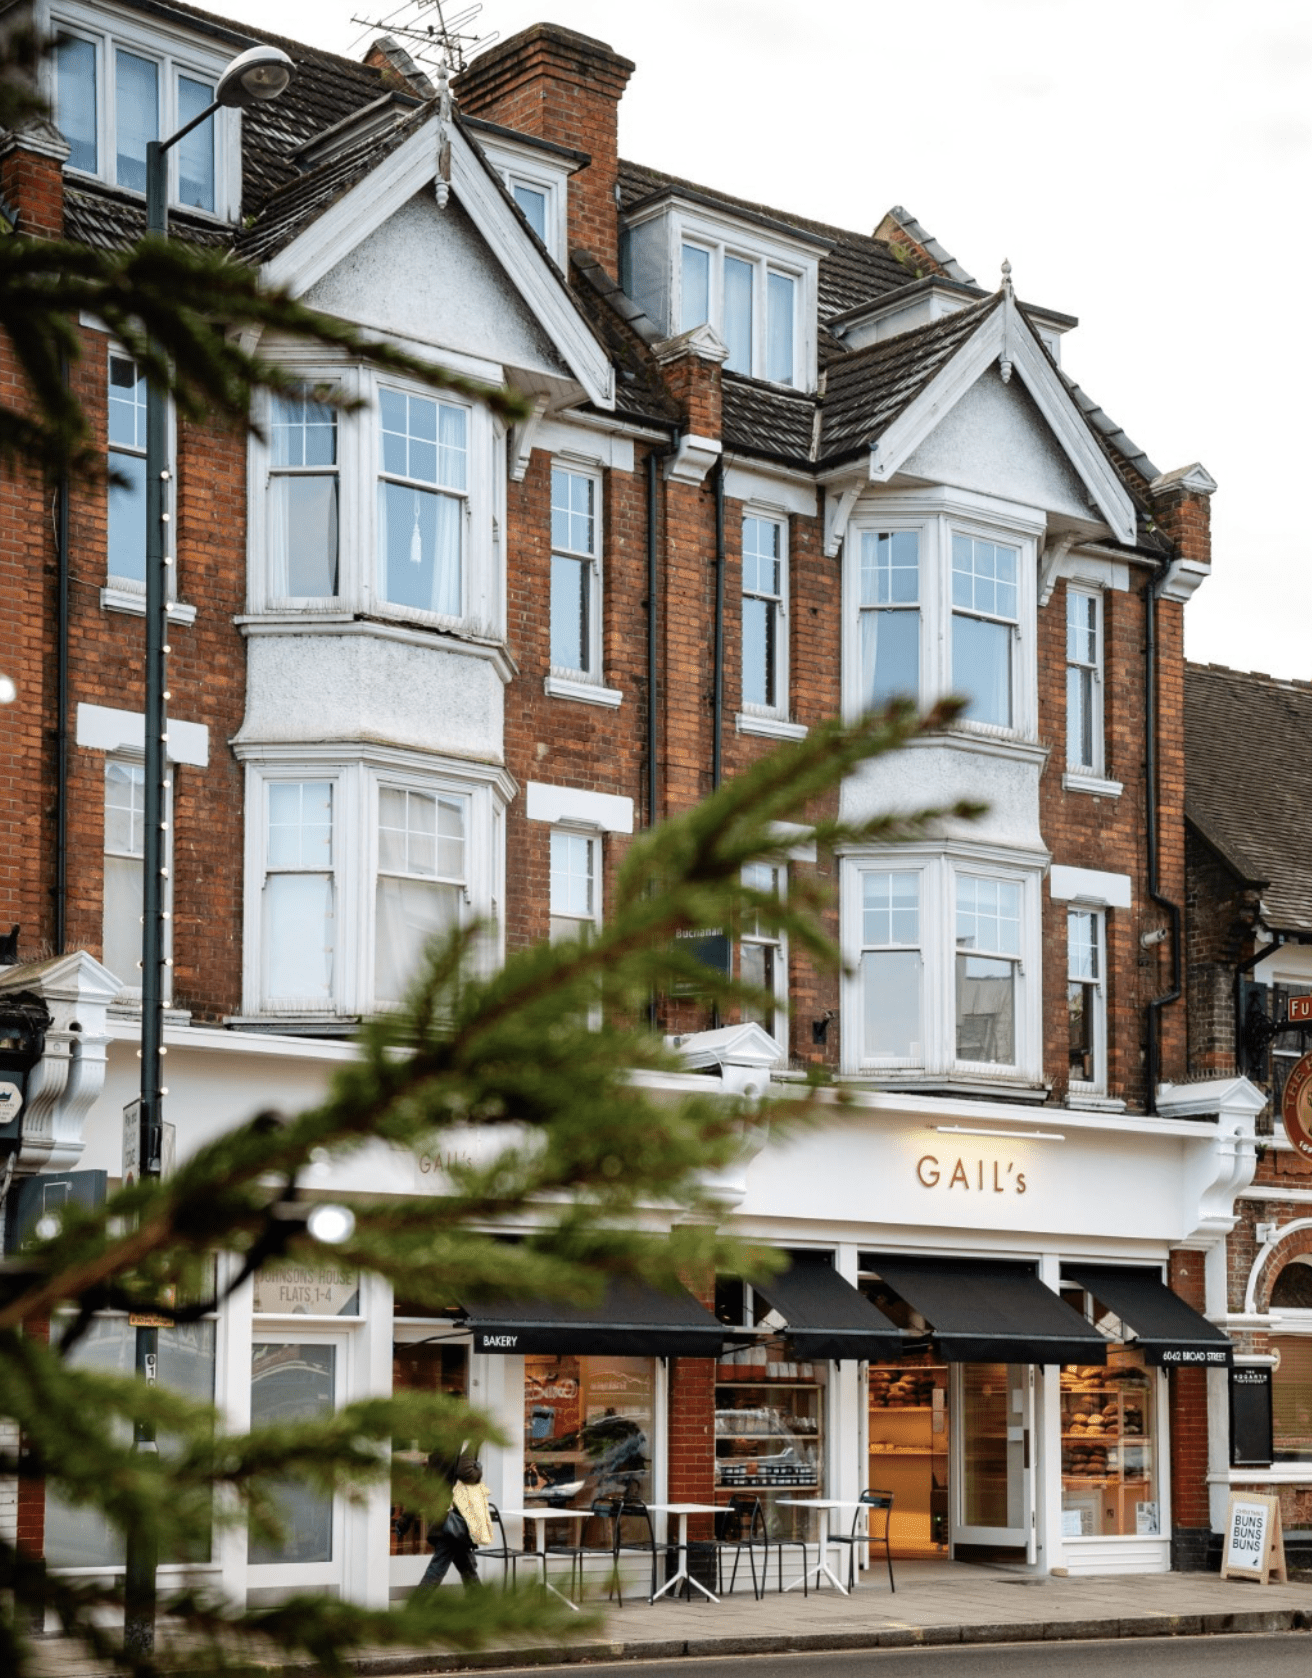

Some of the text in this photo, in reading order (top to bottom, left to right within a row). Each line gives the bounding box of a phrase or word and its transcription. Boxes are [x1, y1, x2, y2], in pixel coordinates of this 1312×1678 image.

[676, 927, 723, 938] Buchanan
[917, 1155, 1026, 1194] GAIL's
[318, 1270, 352, 1286] HOUSE
[280, 1286, 332, 1302] FLATS 1-4
[483, 1335, 518, 1347] BAKERY
[1183, 1351, 1206, 1361] BROAD
[1207, 1352, 1226, 1362] STREET
[1235, 1515, 1263, 1528] BUNS
[1233, 1526, 1262, 1540] BUNS
[1232, 1538, 1260, 1552] BUNS
